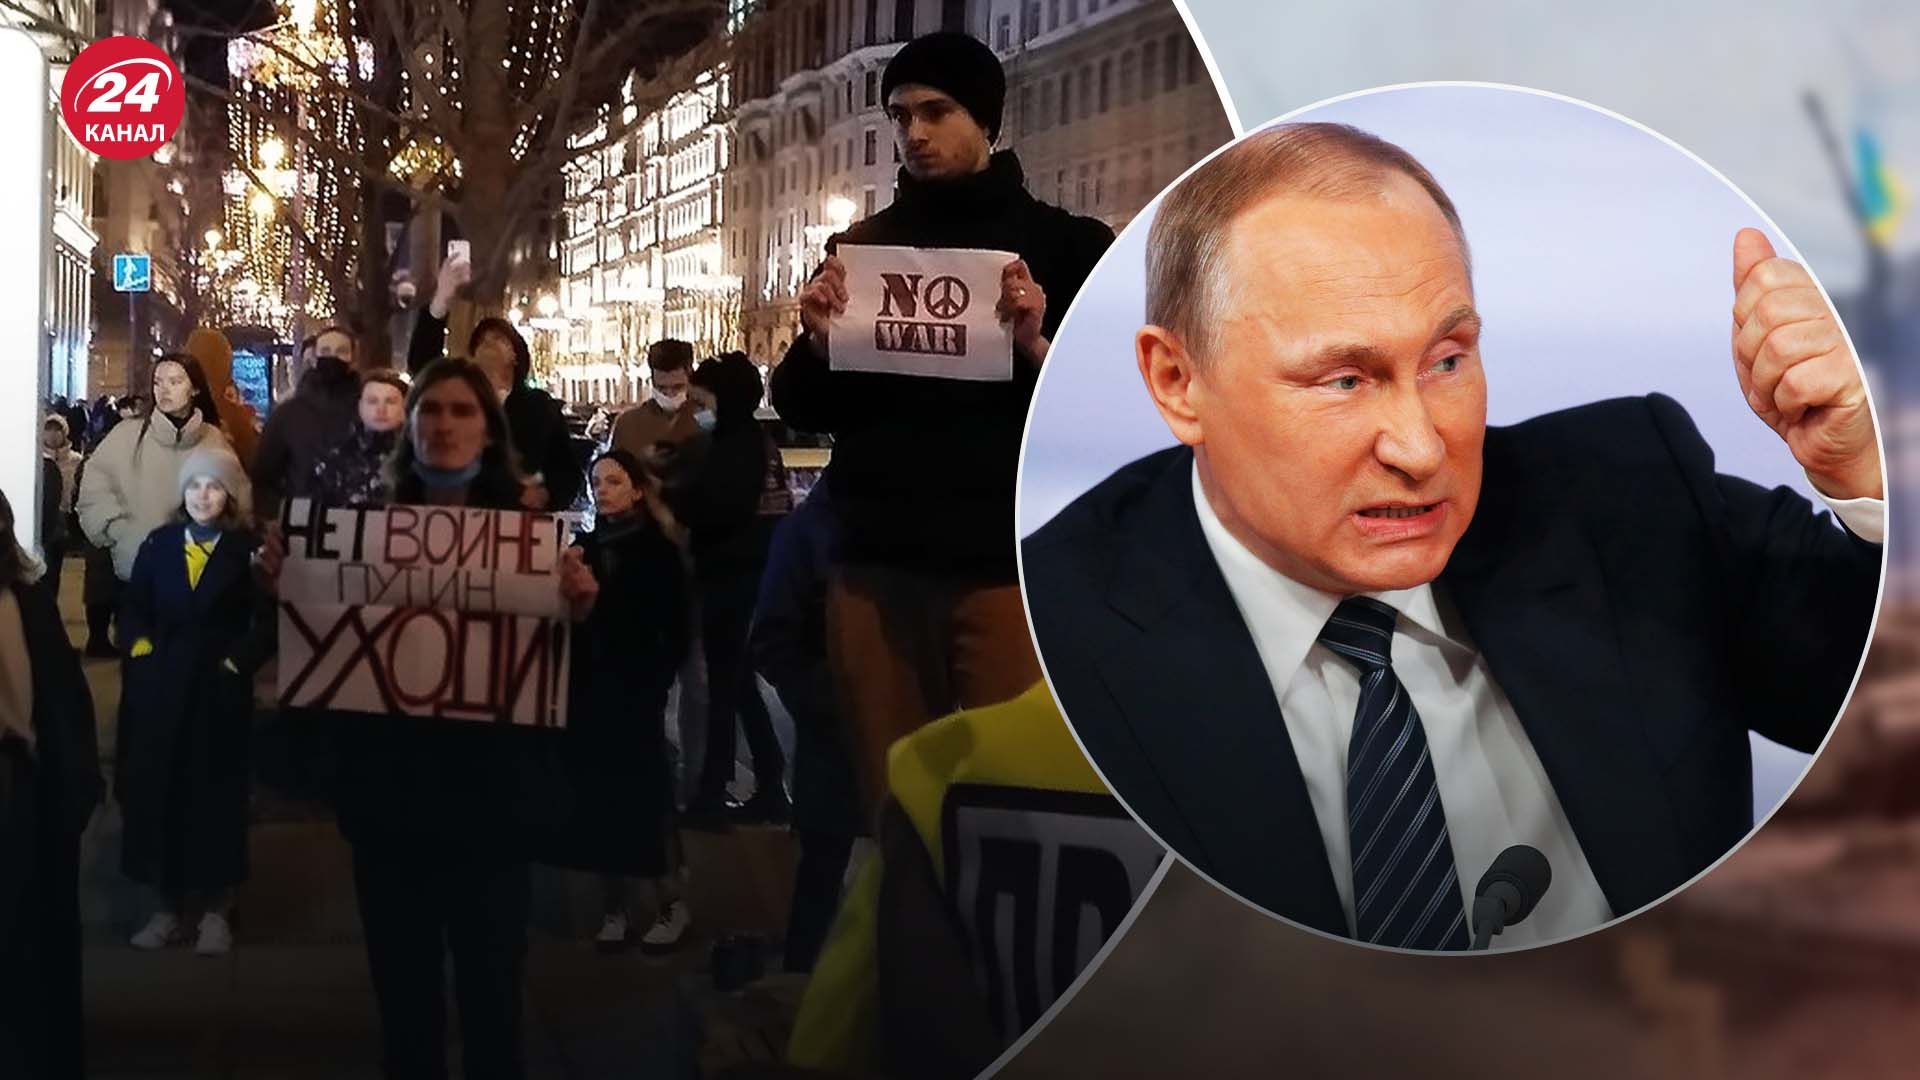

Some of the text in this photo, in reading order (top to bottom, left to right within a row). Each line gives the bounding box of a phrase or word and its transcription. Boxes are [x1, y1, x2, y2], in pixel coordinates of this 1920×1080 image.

[877, 273, 970, 319] NO
[878, 321, 962, 356] WAR
[282, 498, 564, 575] НЕТ ВОЙНЕ!
[337, 562, 497, 612] ПУТИН
[276, 601, 565, 728] УХОДИ!
